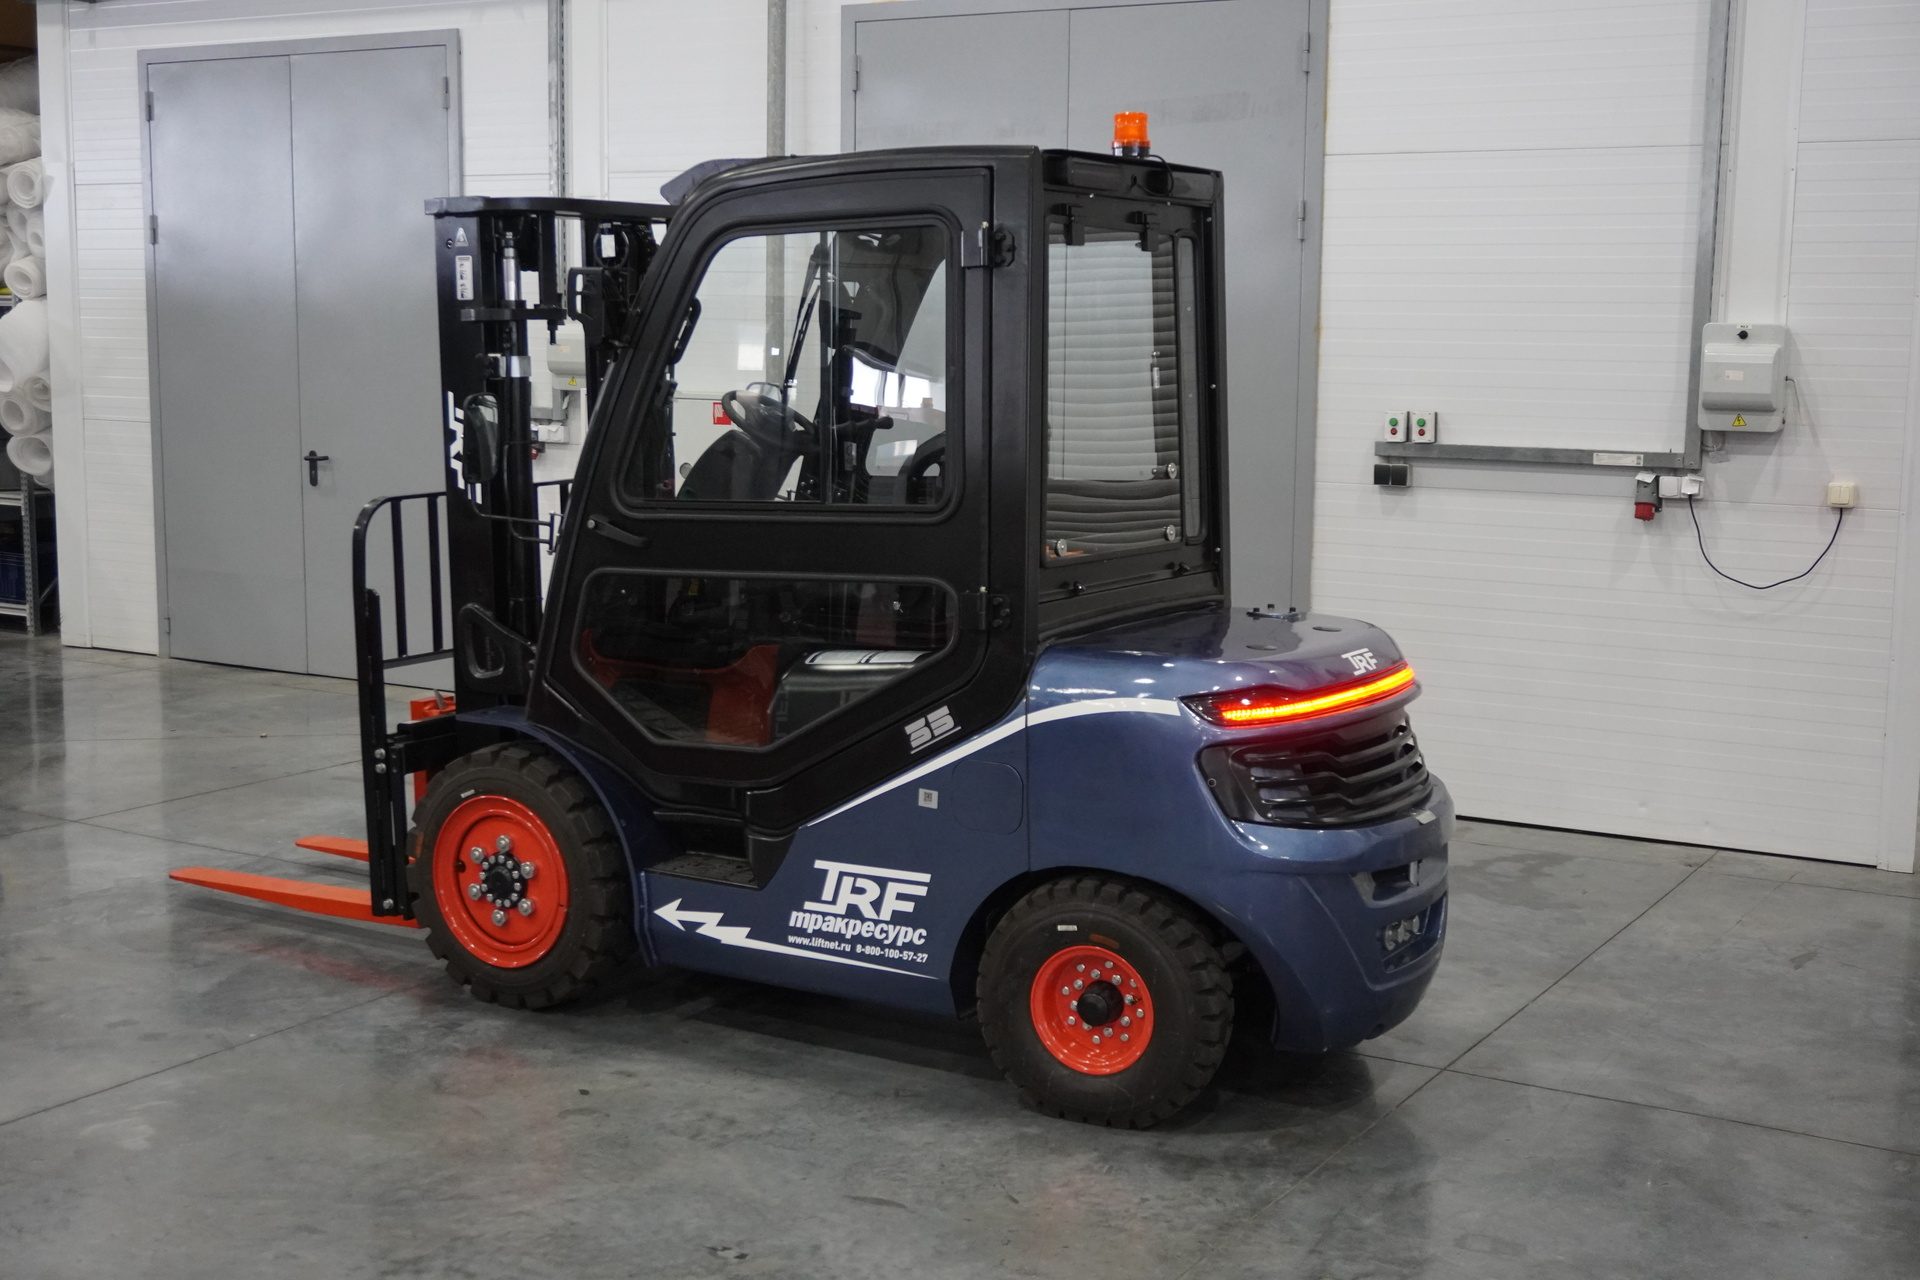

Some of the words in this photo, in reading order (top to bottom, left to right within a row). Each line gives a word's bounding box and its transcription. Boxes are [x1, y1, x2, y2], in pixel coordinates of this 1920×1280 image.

[1341, 647, 1378, 676] TRF
[803, 859, 932, 921] TRF
[788, 911, 928, 946] тракресурс
[787, 934, 852, 952] www.liftnet.ru
[855, 945, 929, 964] 8-800-100-57-27
